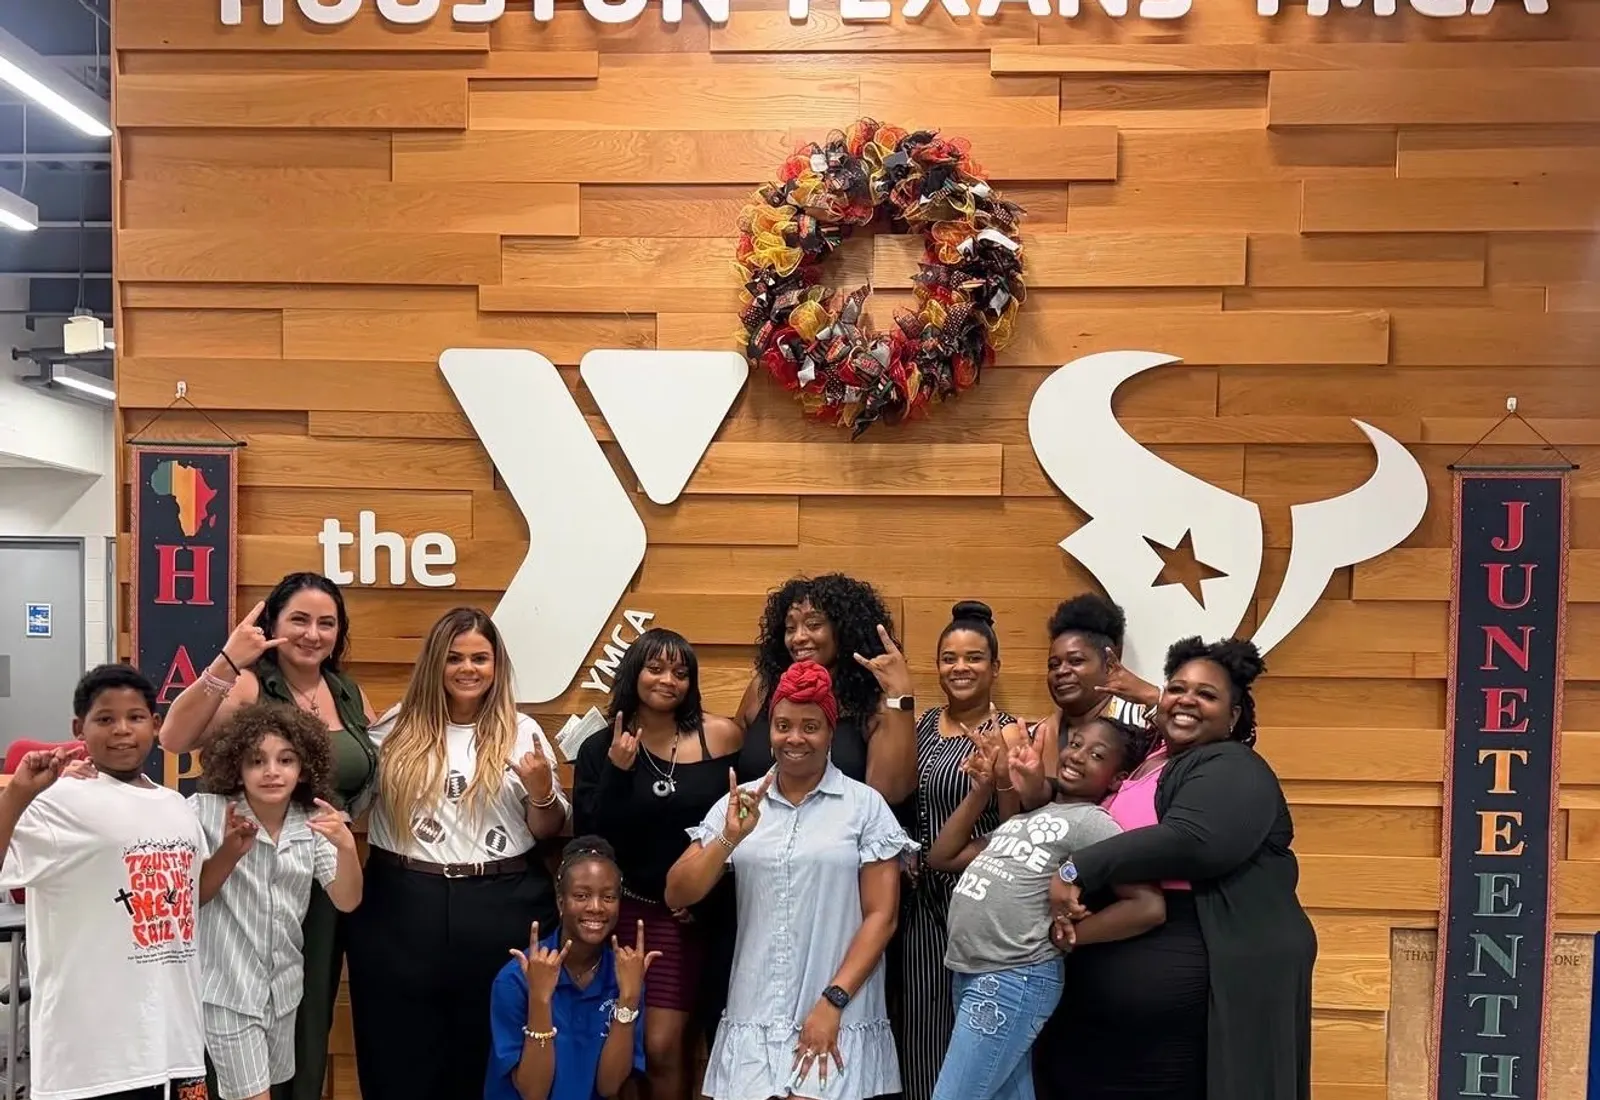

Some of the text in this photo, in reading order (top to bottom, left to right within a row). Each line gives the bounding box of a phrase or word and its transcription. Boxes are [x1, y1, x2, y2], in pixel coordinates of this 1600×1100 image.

[318, 510, 457, 587] the
[580, 609, 655, 694] YMCA
[1458, 500, 1539, 1099] JUNETEENTH
